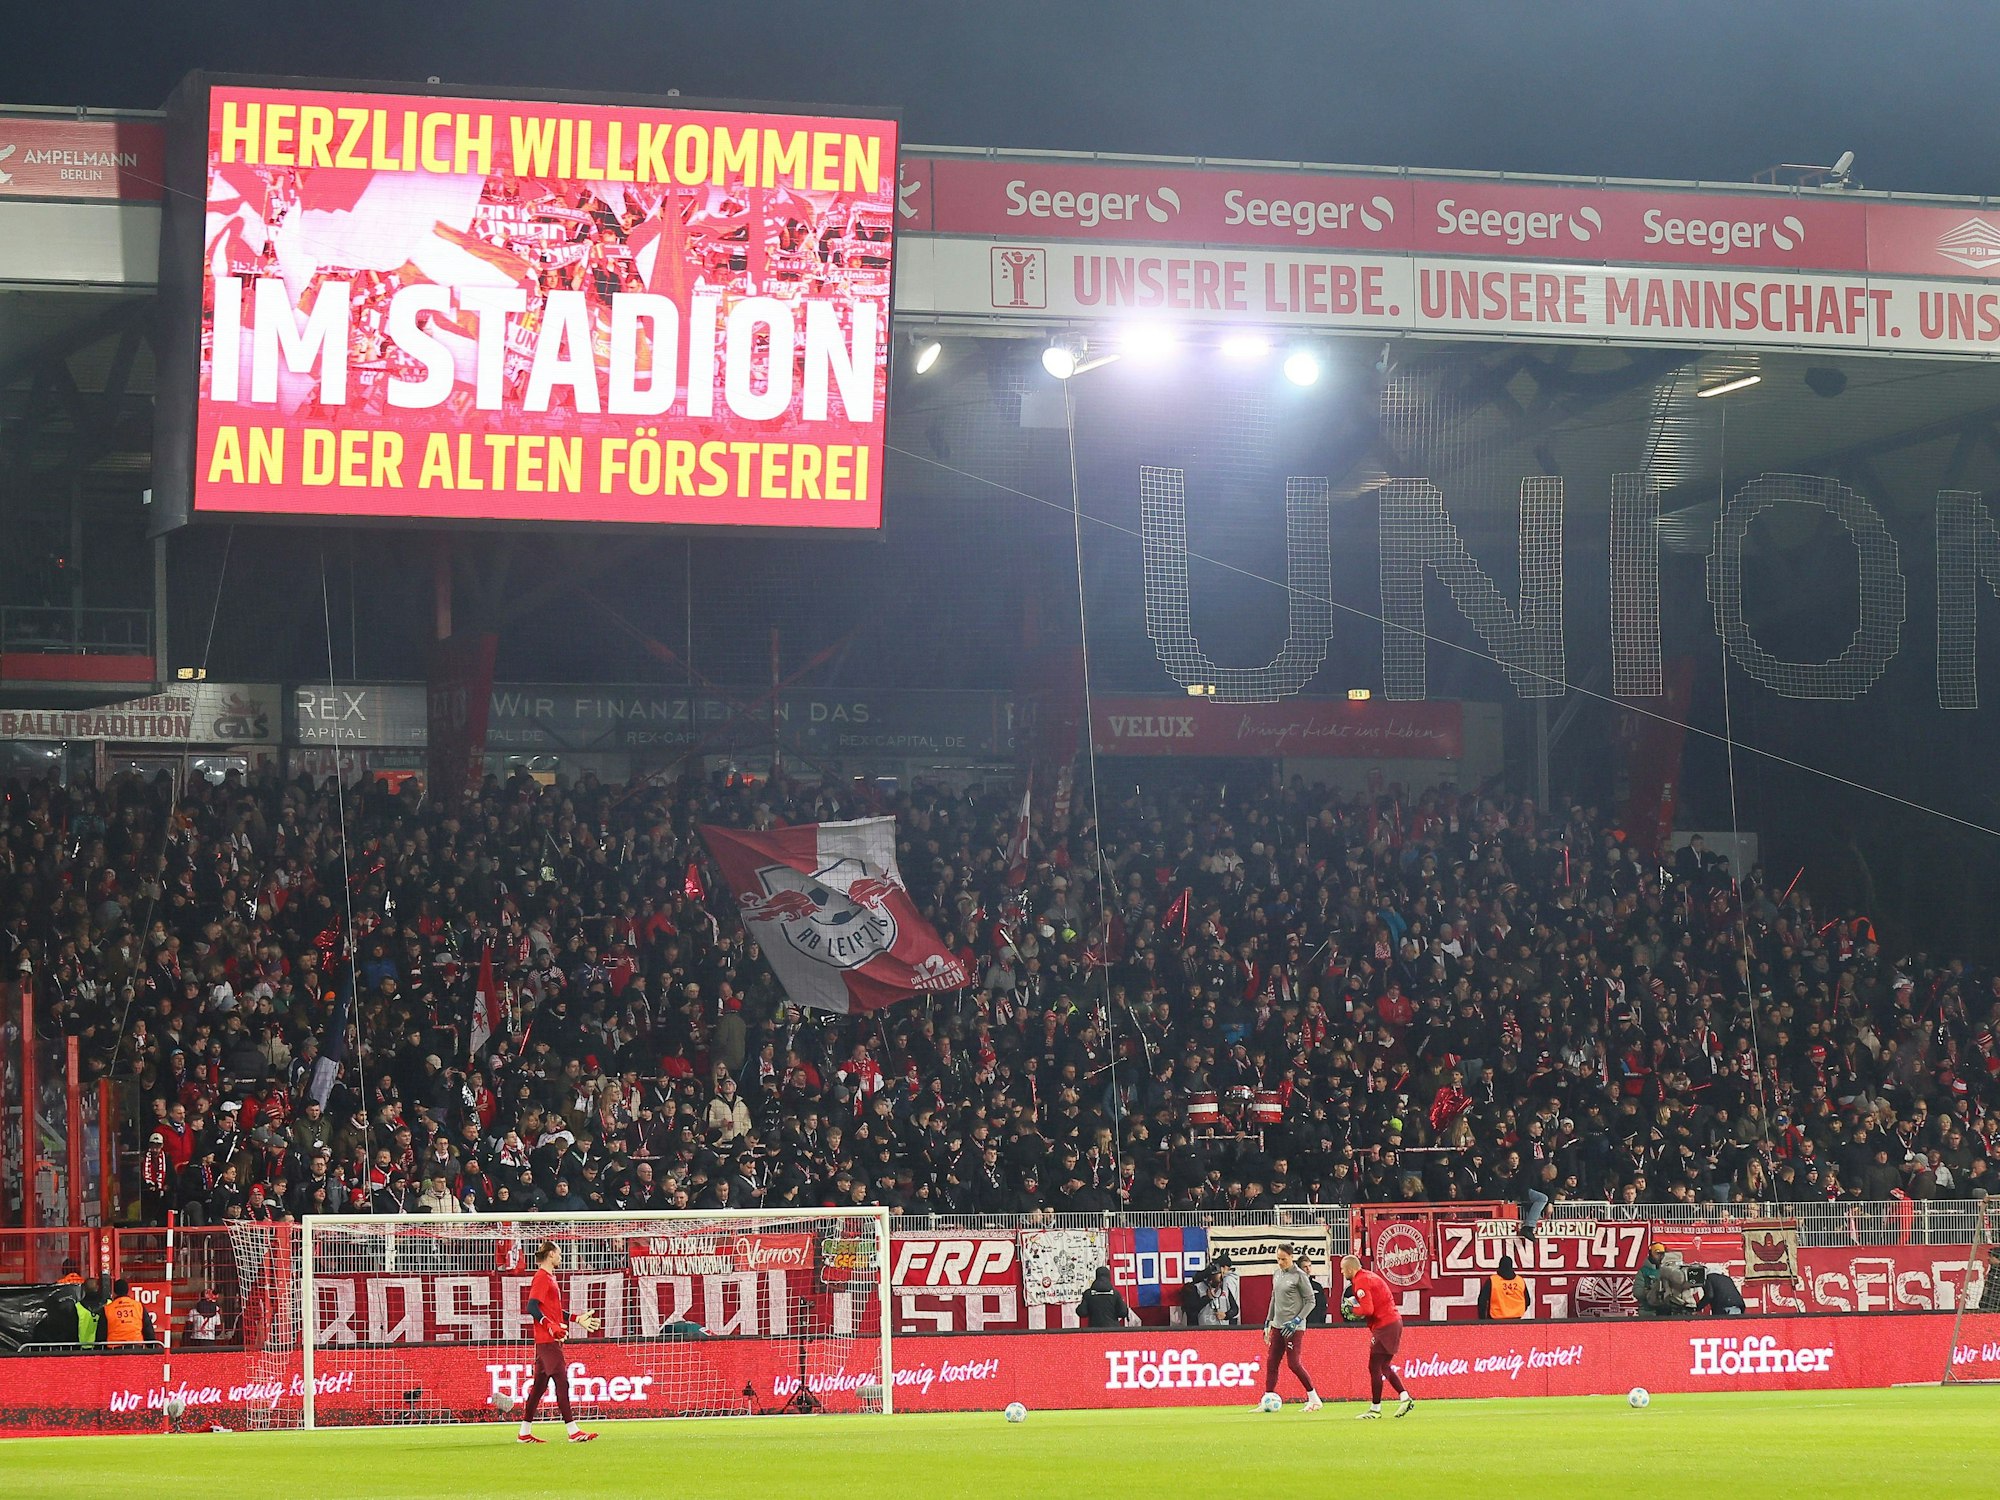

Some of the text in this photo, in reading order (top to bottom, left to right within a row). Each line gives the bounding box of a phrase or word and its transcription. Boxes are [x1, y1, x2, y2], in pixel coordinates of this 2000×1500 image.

[24, 148, 137, 167] AMPELMANN
[220, 101, 881, 194] HERZLICH WILLKOMMEN
[60, 169, 103, 181] BERLIN
[1005, 180, 1139, 227] Seeger
[1224, 189, 1354, 236] Seeger
[1436, 199, 1563, 245] Seeger
[1644, 209, 1766, 254] Seeger
[1969, 247, 1986, 255] PBI
[1072, 255, 1248, 312] UNSERE
[1265, 262, 1400, 316] LIEBE.
[1419, 268, 1587, 324] UNSERE
[1605, 276, 1901, 338] MANNSCHAFT.
[211, 276, 878, 422] IM STADION
[208, 425, 869, 500] AN DER ALTEN FÖRSTEREI
[164, 696, 190, 711] DIE
[297, 691, 367, 721] REX
[491, 693, 554, 718] WIR
[298, 727, 367, 739] CAPITAL
[1108, 715, 1194, 737] VELUX
[827, 916, 889, 958] LEIPZIG
[649, 1236, 716, 1255] AND AFTER ALL
[1476, 1220, 1597, 1237] ZONE JUGEND
[662, 1256, 674, 1275] MY
[675, 1254, 733, 1275] WONDERWALL
[736, 1236, 811, 1269] Vamos!
[891, 1240, 1016, 1286] FRP
[1445, 1227, 1565, 1269] ZONE
[1576, 1226, 1646, 1269] 147
[1113, 1251, 1206, 1286] 2009
[132, 1286, 160, 1304] Tor
[1502, 1282, 1518, 1291] 342
[117, 1309, 134, 1319] 931
[1105, 1348, 1259, 1390] Höffner
[1404, 1353, 1469, 1379] Wohnen
[1474, 1349, 1525, 1380] wenig
[1526, 1345, 1584, 1369] kostet!
[1689, 1334, 1832, 1375] Höffner
[1952, 1344, 1979, 1365] Wo
[110, 1389, 143, 1412] Wo
[147, 1381, 223, 1409] Wohnen
[228, 1376, 286, 1408] wenig
[773, 1375, 803, 1396] Wo
[809, 1367, 877, 1393] Wohnen
[939, 1358, 999, 1384] kostet!
